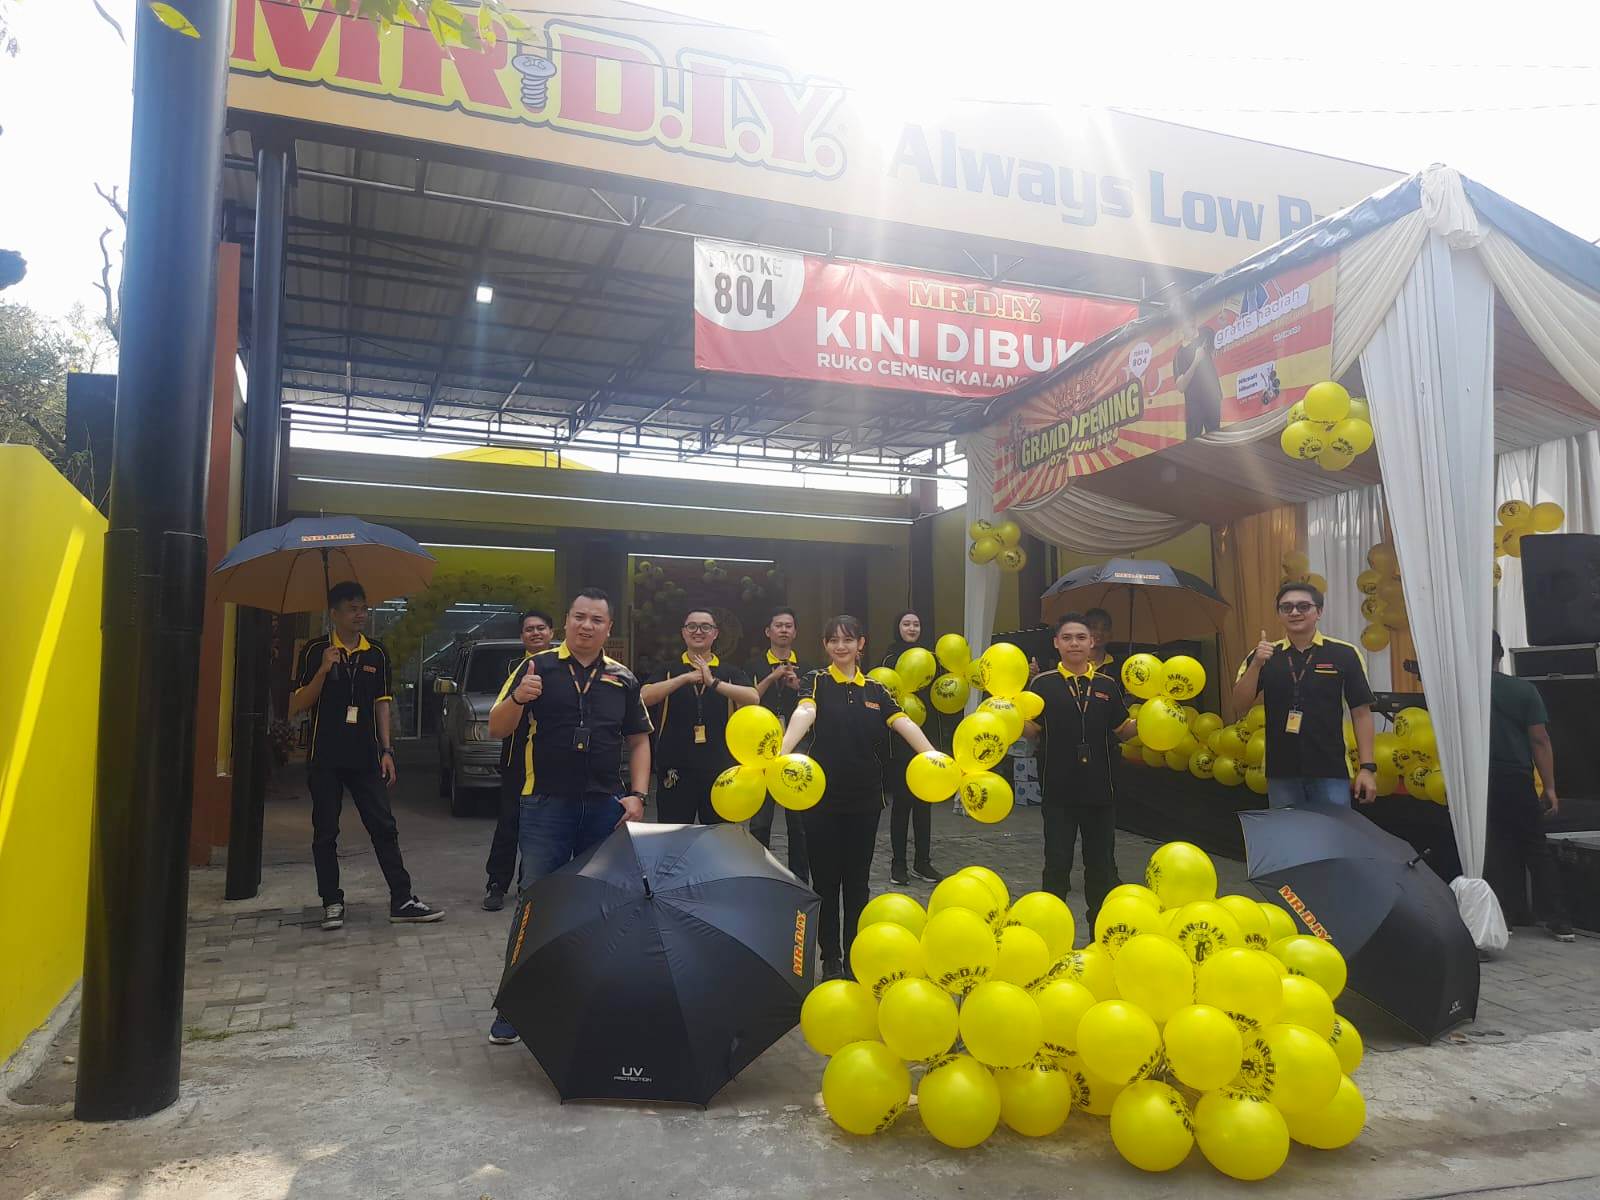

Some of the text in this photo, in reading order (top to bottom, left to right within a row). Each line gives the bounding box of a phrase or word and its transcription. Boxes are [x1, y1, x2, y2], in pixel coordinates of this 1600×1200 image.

[886, 122, 1134, 226] Always
[1149, 169, 1265, 241] Low
[714, 272, 775, 318] 804
[816, 306, 919, 359] KINI
[817, 353, 1029, 390] RUKO CEMENGKALAN
[1021, 422, 1070, 468] GRAND
[622, 1066, 643, 1076] UV
